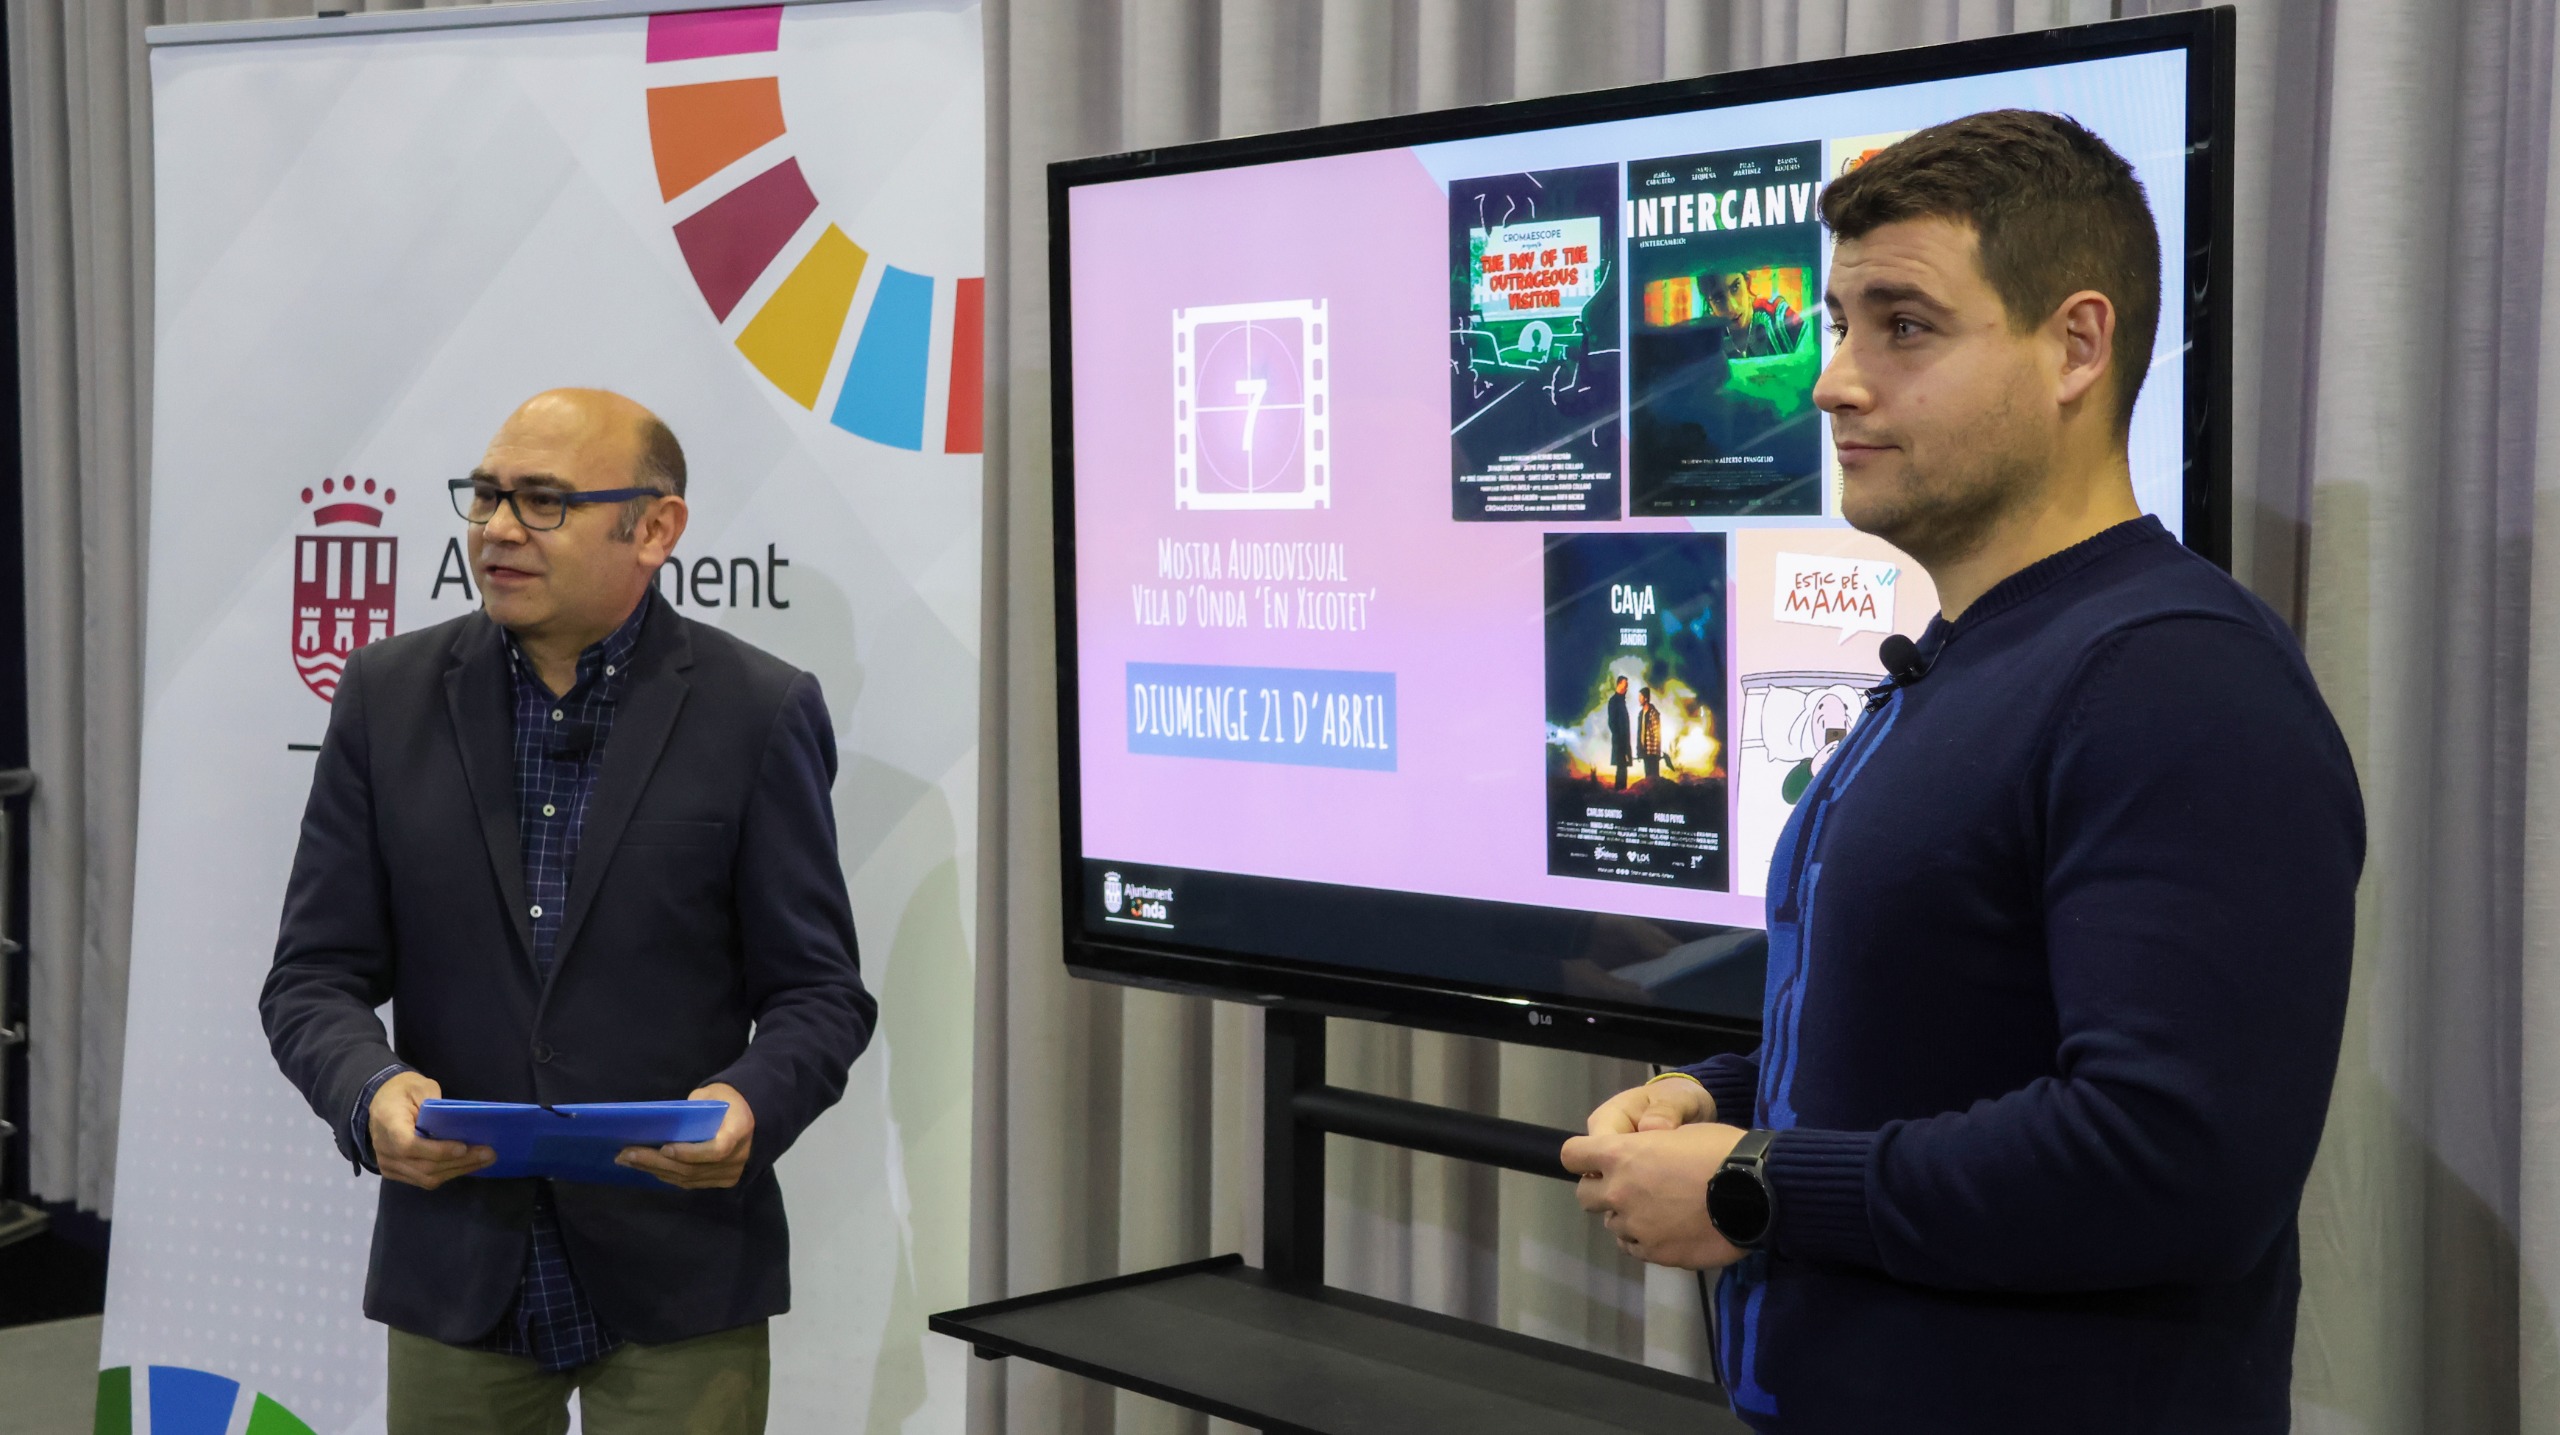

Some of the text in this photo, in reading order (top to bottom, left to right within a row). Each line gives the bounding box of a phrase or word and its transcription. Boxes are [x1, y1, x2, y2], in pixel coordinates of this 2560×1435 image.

[1503, 229, 1562, 243] CROMAESCOPE
[1480, 246, 1588, 273] THE DAY OF THE
[1490, 268, 1579, 292] OUTRAGEOUS
[1508, 289, 1560, 310] VISITOR
[1235, 378, 1267, 451] 7
[1795, 571, 1836, 590] ESTIC
[1611, 584, 1655, 620] CAVA
[1134, 683, 1388, 750] DIUMENGE 21 D'ABRIL
[1124, 883, 1173, 901] Ajuntament
[1131, 899, 1166, 919] Onda
